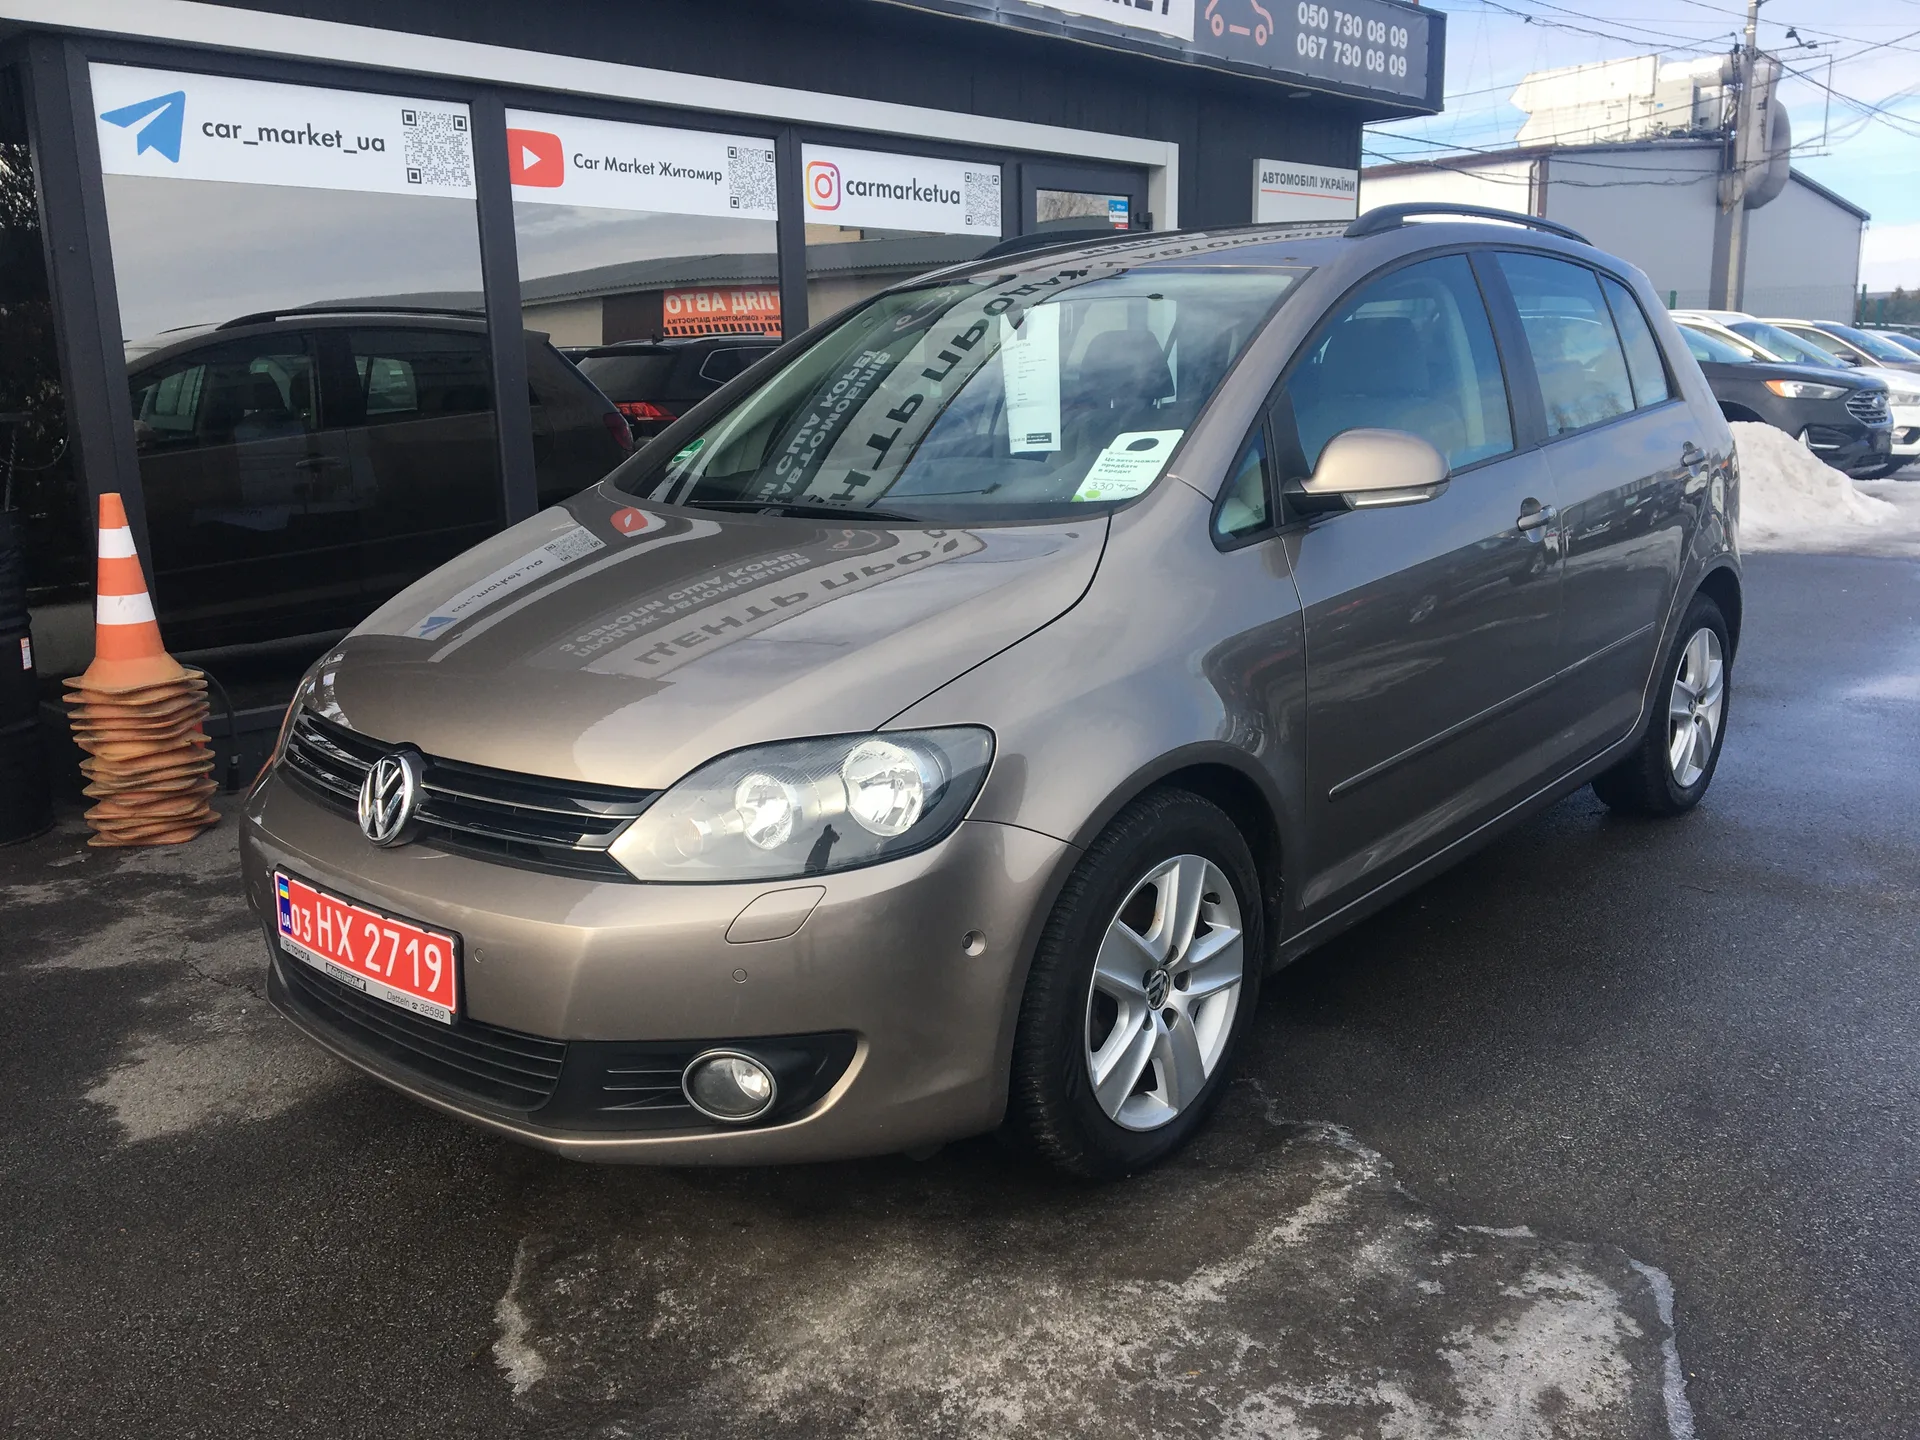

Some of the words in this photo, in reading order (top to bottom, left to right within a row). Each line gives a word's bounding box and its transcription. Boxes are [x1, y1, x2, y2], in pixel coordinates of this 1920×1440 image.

[1298, 1, 1329, 30] 050
[1334, 10, 1363, 38] 730
[1367, 20, 1386, 44] 08
[1390, 25, 1409, 49] 09
[1297, 32, 1328, 60] 067
[1333, 40, 1362, 67] 730
[1366, 49, 1385, 73] 08
[1389, 54, 1407, 78] 09
[201, 122, 386, 154] car_market_ua
[573, 152, 601, 170] Car
[604, 156, 656, 175] Market
[658, 161, 723, 185] Житомир
[1262, 171, 1318, 188] АВТОМОБІЛІ
[1320, 176, 1356, 193] УКРАЇНИ
[846, 177, 961, 206] carmarketua
[281, 911, 292, 929] UA
[364, 922, 442, 993] 2719
[290, 944, 311, 963] TOYOTA
[419, 1003, 445, 1020] 32599
